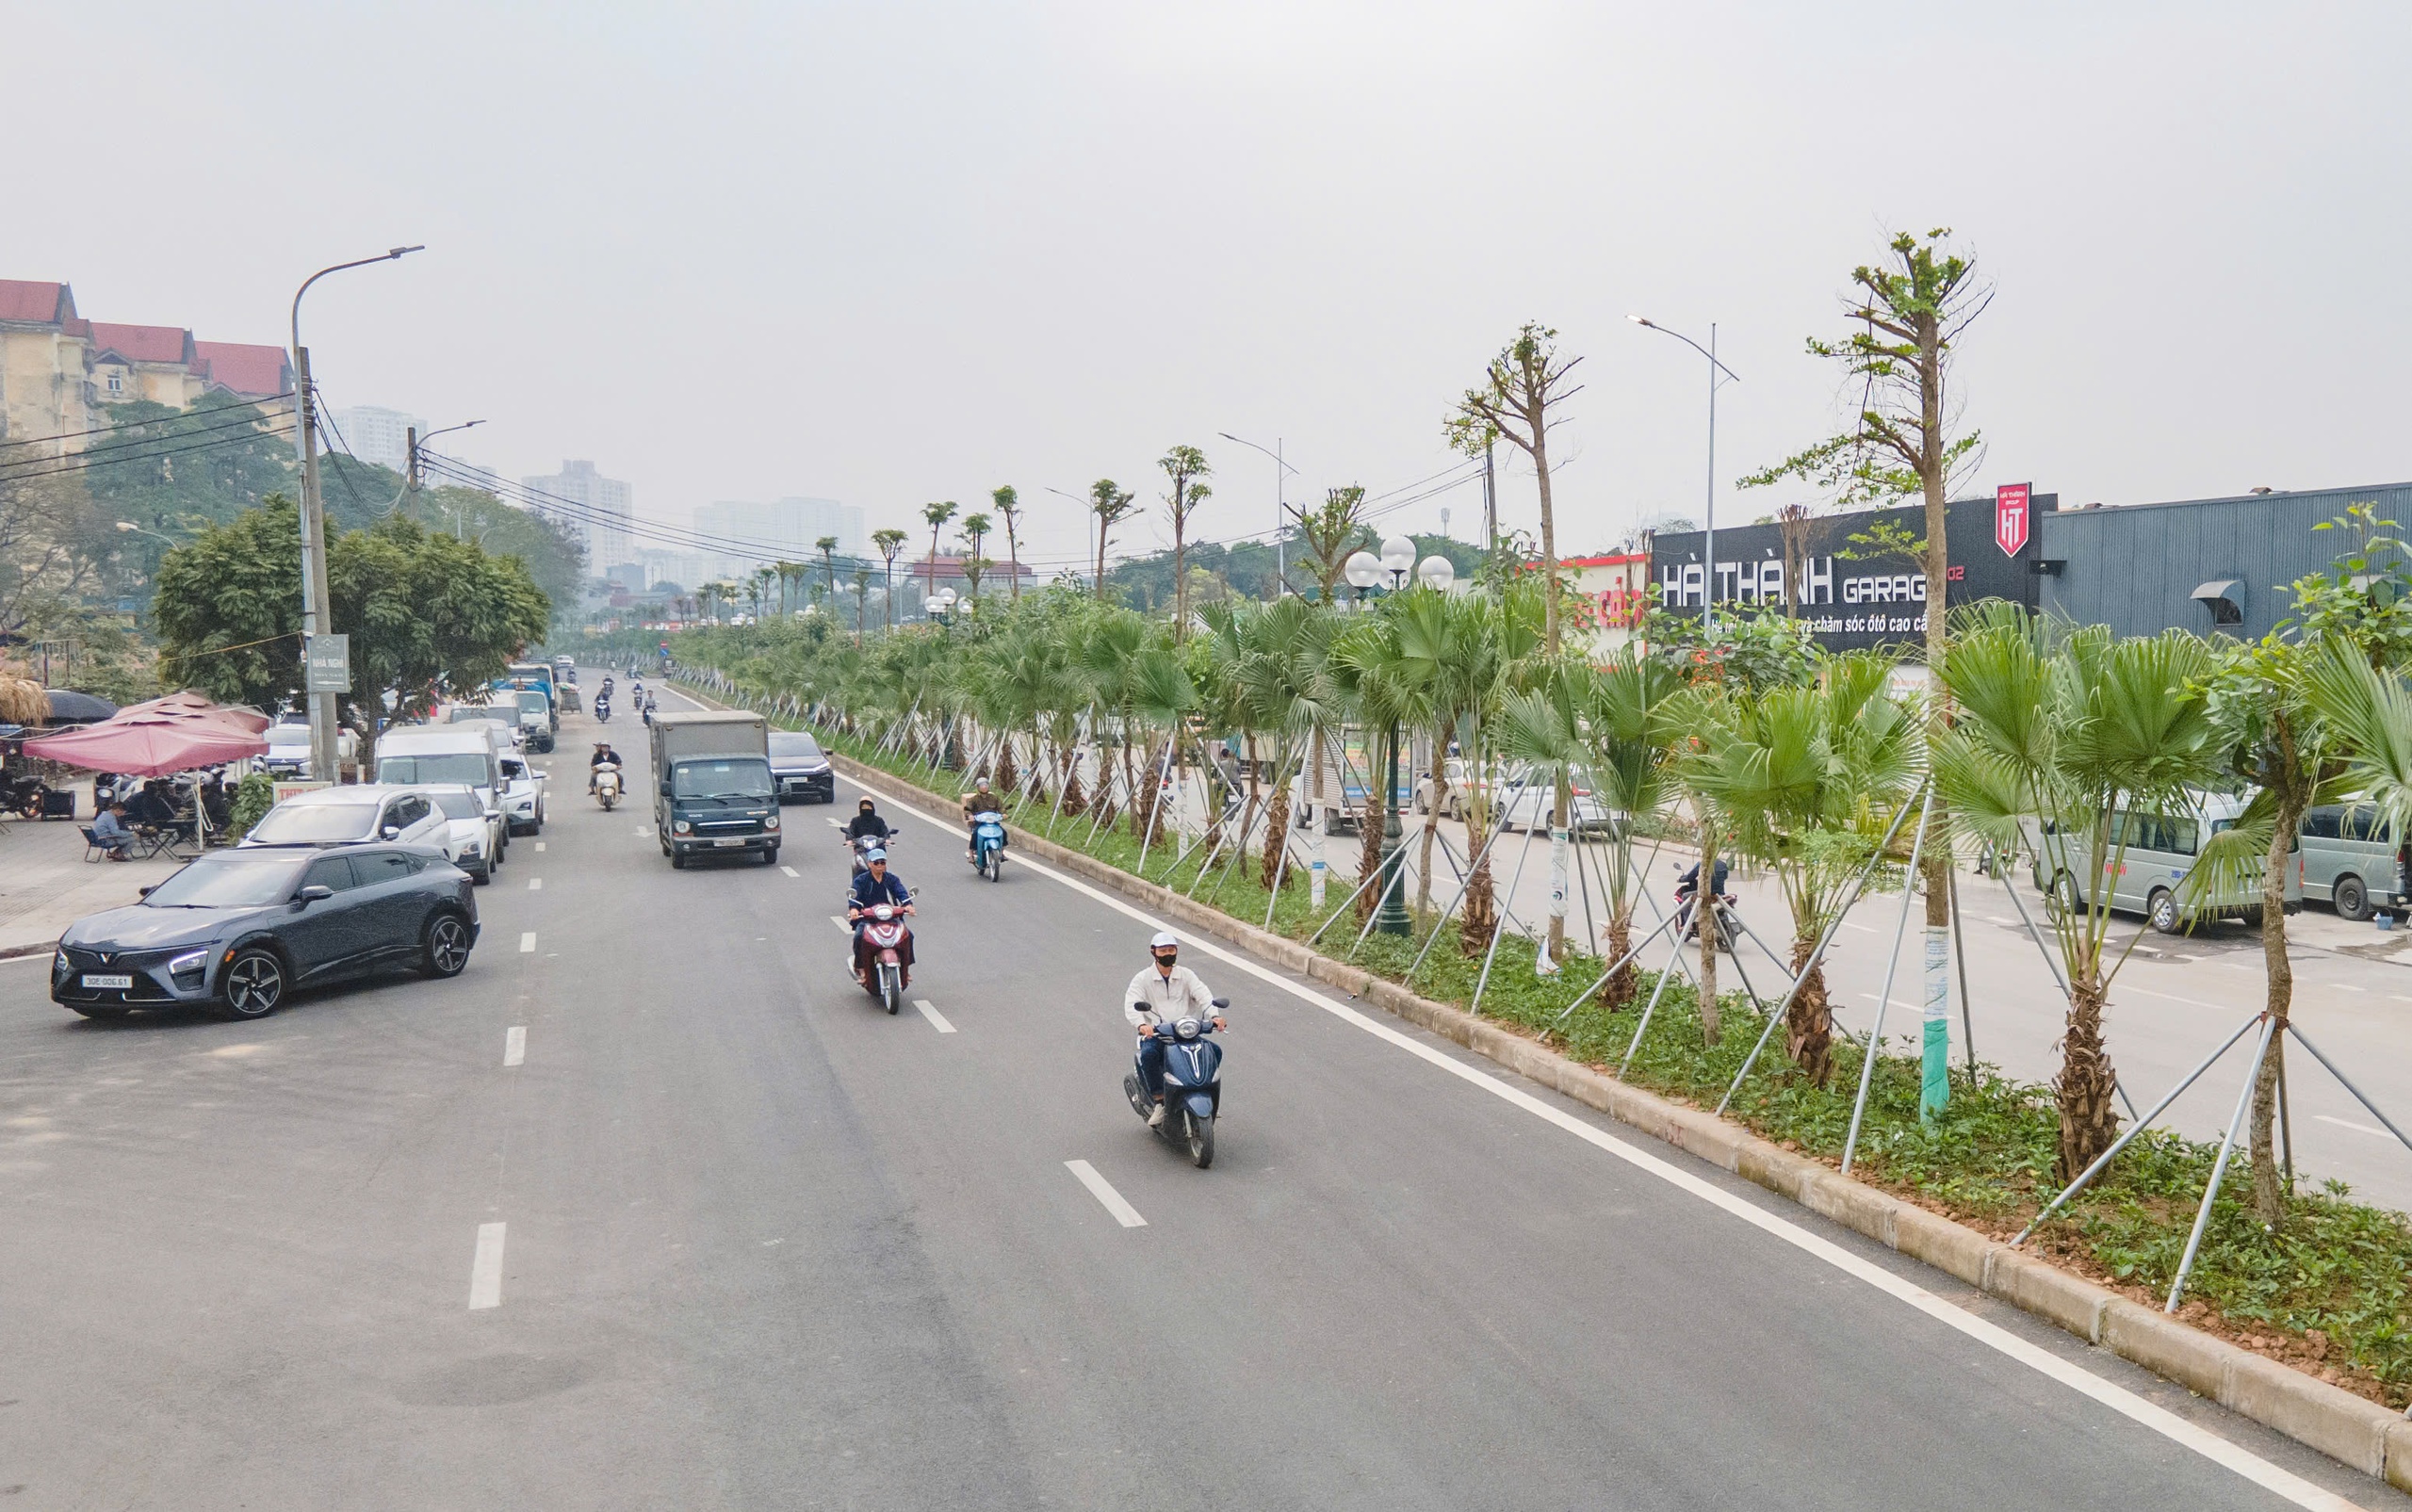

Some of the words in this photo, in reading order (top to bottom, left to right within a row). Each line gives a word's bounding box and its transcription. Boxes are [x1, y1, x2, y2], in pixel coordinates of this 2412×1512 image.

[2001, 508, 2023, 549] HT
[1663, 552, 1704, 607] HÀ
[1843, 575, 1928, 604] GARAG
[1845, 614, 1866, 632] sóc
[1889, 618, 1910, 632] cao
